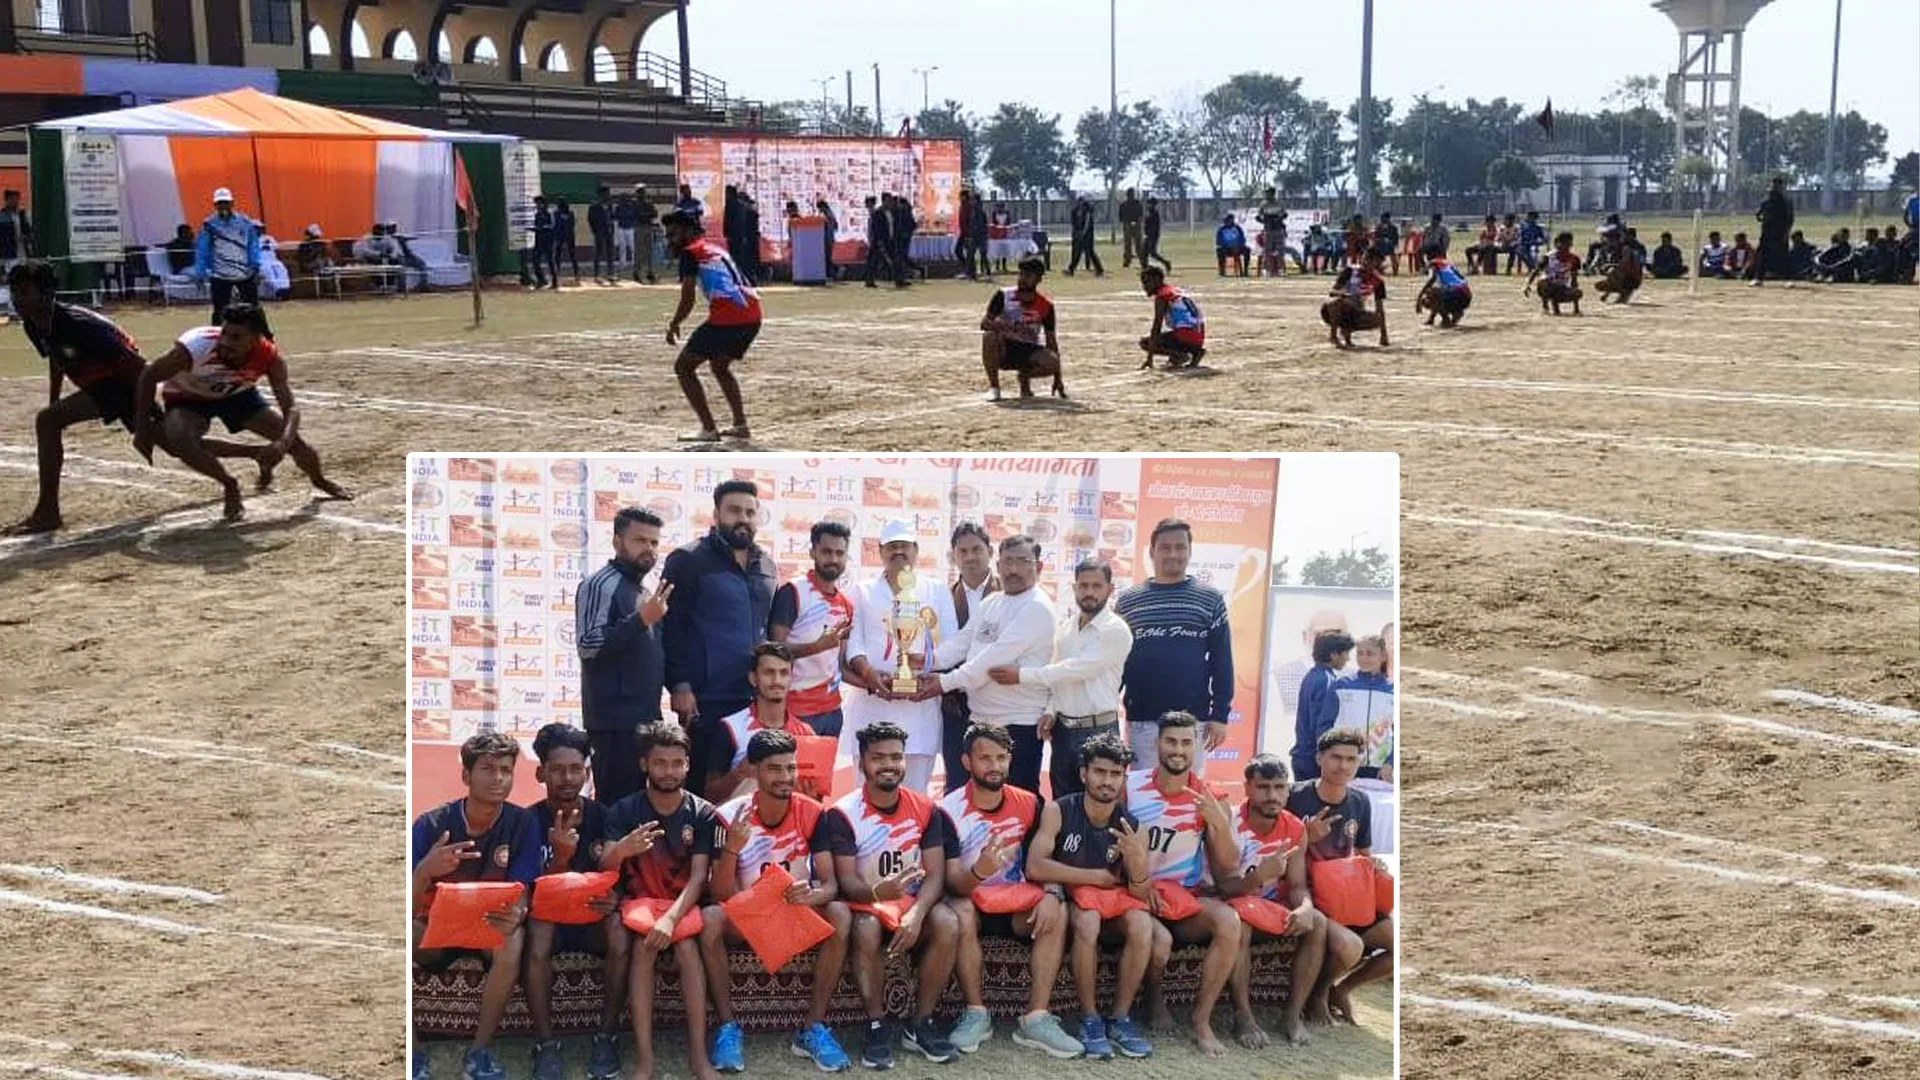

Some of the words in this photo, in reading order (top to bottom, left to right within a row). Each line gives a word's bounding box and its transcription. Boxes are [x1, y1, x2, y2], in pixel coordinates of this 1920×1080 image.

[553, 508, 586, 517] INDIA
[412, 533, 441, 542] NDIA
[457, 600, 490, 609] INDIA
[412, 634, 442, 643] NDIA
[554, 669, 579, 679] INDI
[412, 698, 443, 707] NDIA
[1063, 832, 1082, 853] 08
[1148, 825, 1177, 854] 07
[878, 850, 905, 878] 05
